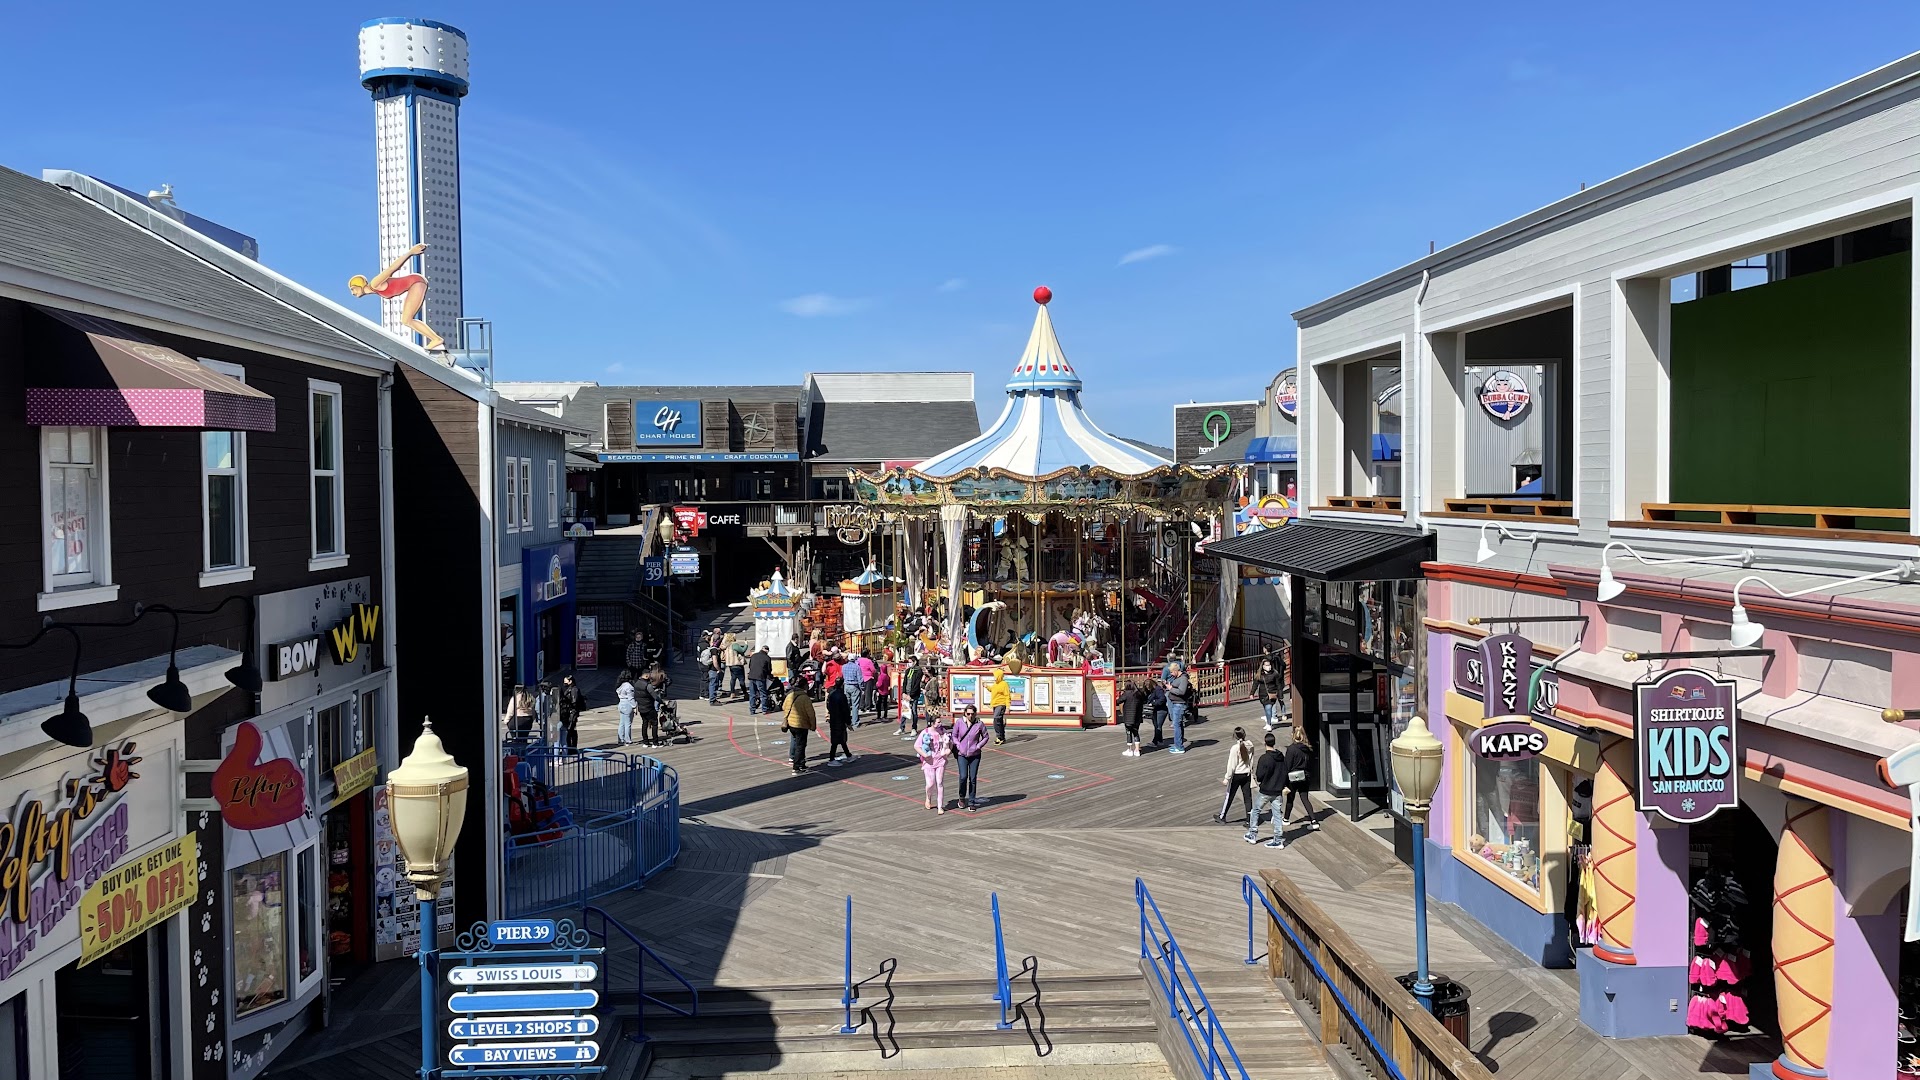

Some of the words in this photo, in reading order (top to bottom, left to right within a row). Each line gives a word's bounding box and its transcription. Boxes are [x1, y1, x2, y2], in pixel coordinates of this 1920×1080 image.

[1483, 392, 1507, 402] BUBBA
[1508, 392, 1528, 402] GUMP
[653, 405, 681, 431] CH
[709, 514, 740, 525] CAFFÈ
[645, 568, 662, 580] 39
[1326, 609, 1335, 621] San
[1335, 612, 1356, 627] Francisco
[280, 638, 318, 676] BOW
[1500, 641, 1516, 710] KRAZY
[1650, 707, 1725, 722] SHIRTIQUE
[1481, 733, 1544, 753] KAPS
[1648, 725, 1731, 778] KIDS
[225, 774, 296, 808] Lefty's
[1652, 780, 1673, 794] SAN
[1674, 778, 1725, 793] FRANCISCO
[102, 872, 122, 896] BUY
[124, 861, 145, 885] ONE,
[147, 852, 163, 873] GET
[165, 842, 182, 863] ONE
[0, 930, 37, 981] LEFT
[41, 886, 81, 937] HAND
[84, 834, 129, 890] STORE
[97, 884, 142, 943] 50%
[146, 860, 185, 914] OFF!
[122, 930, 138, 942] STORE
[496, 926, 533, 940] PIER
[533, 925, 550, 939] 39
[476, 969, 518, 982] SWISS
[522, 968, 562, 980] LOUIS
[470, 1023, 511, 1036] LEVEL
[514, 1023, 523, 1034] 2
[526, 1021, 572, 1034] SHOPS
[484, 1050, 510, 1061] BAY
[512, 1048, 557, 1060] VIEWS
